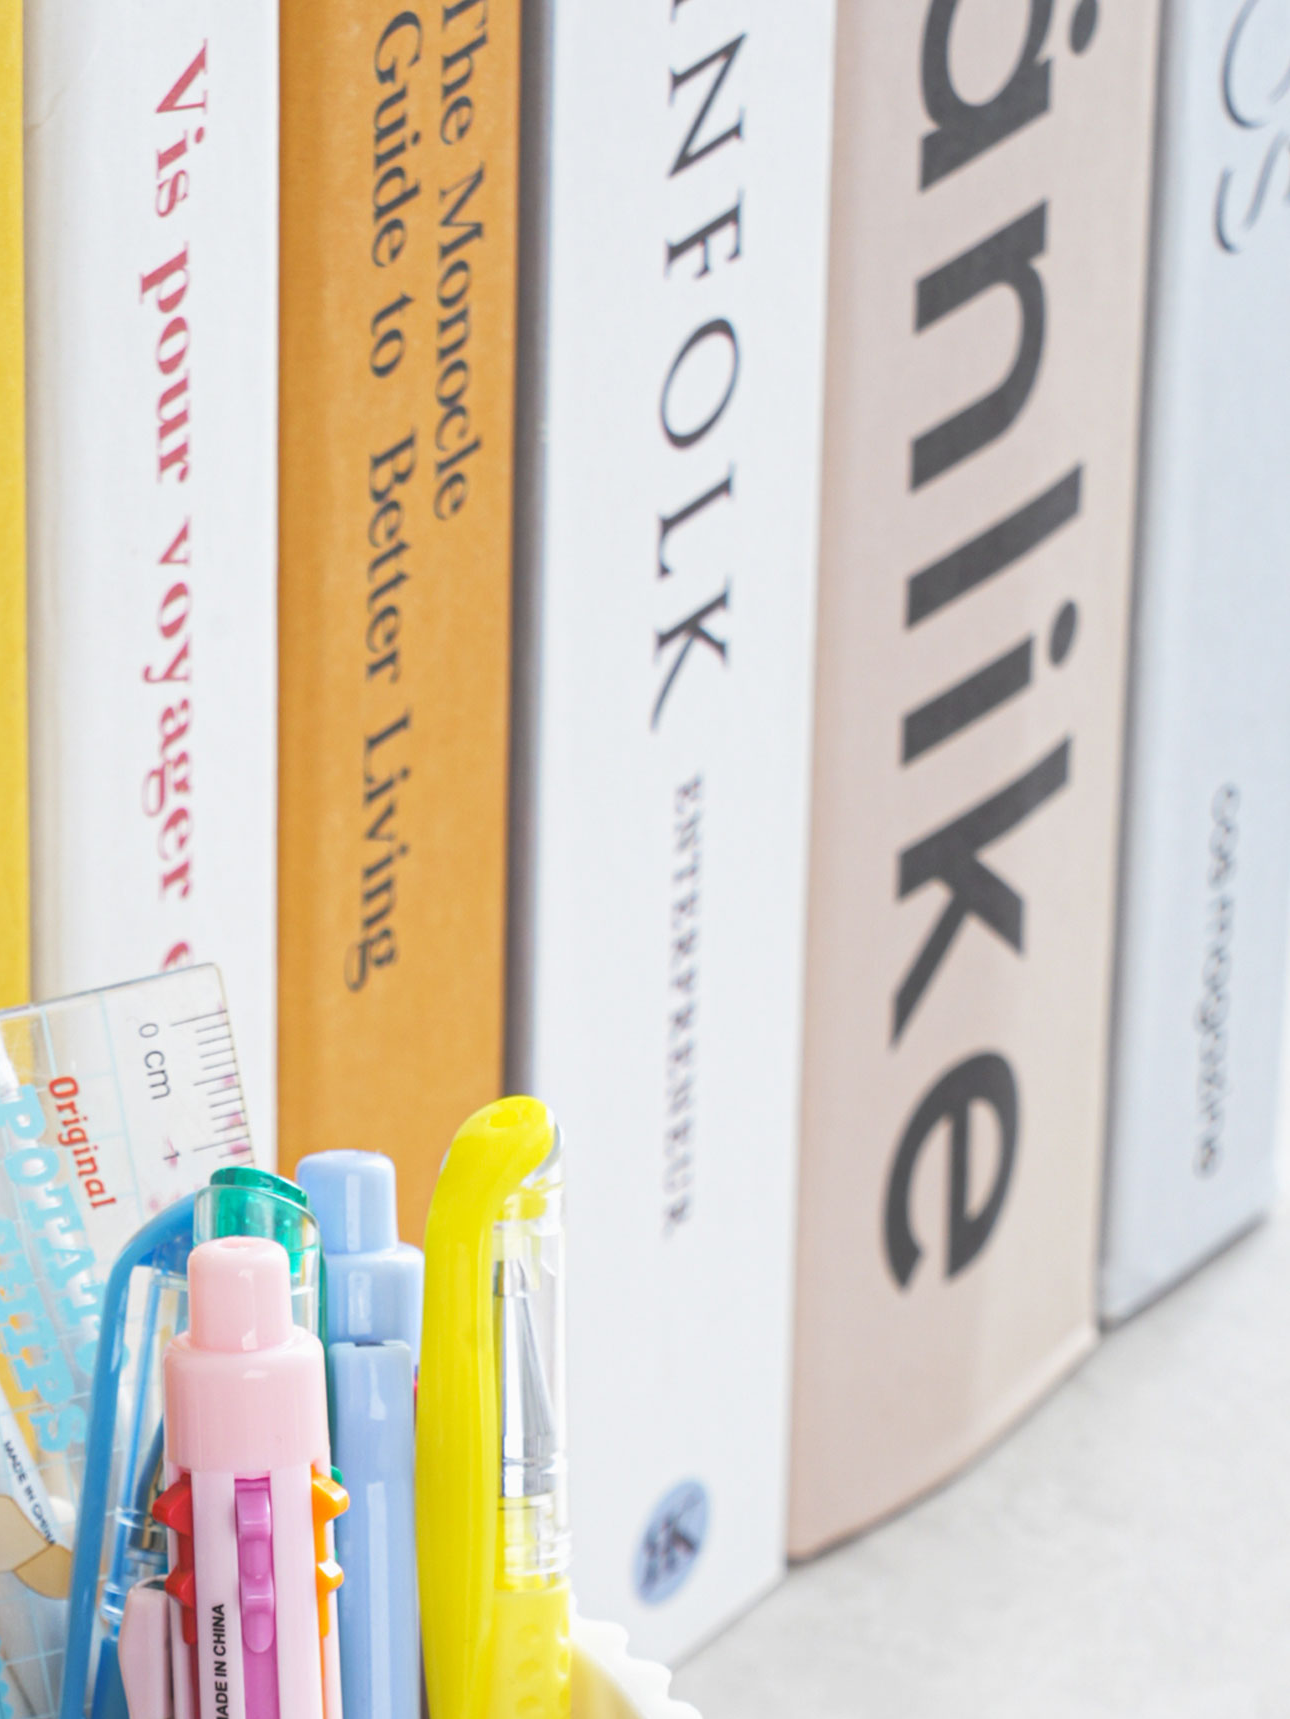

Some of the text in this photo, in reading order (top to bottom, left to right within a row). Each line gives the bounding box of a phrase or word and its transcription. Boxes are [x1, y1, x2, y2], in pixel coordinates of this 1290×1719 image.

[155, 38, 208, 219] Vis
[141, 241, 191, 484] pour
[433, 160, 486, 522] Monocle
[651, 0, 746, 732] NFOLK
[344, 10, 423, 992] Guide to Better Living
[142, 516, 193, 900] voyager
[48, 1076, 116, 1209] Original
[144, 1050, 171, 1100] cm
[4, 1440, 27, 1484] MADE
[23, 1485, 36, 1502] IN
[212, 1603, 227, 1657] CHINA
[214, 1660, 227, 1677] IN
